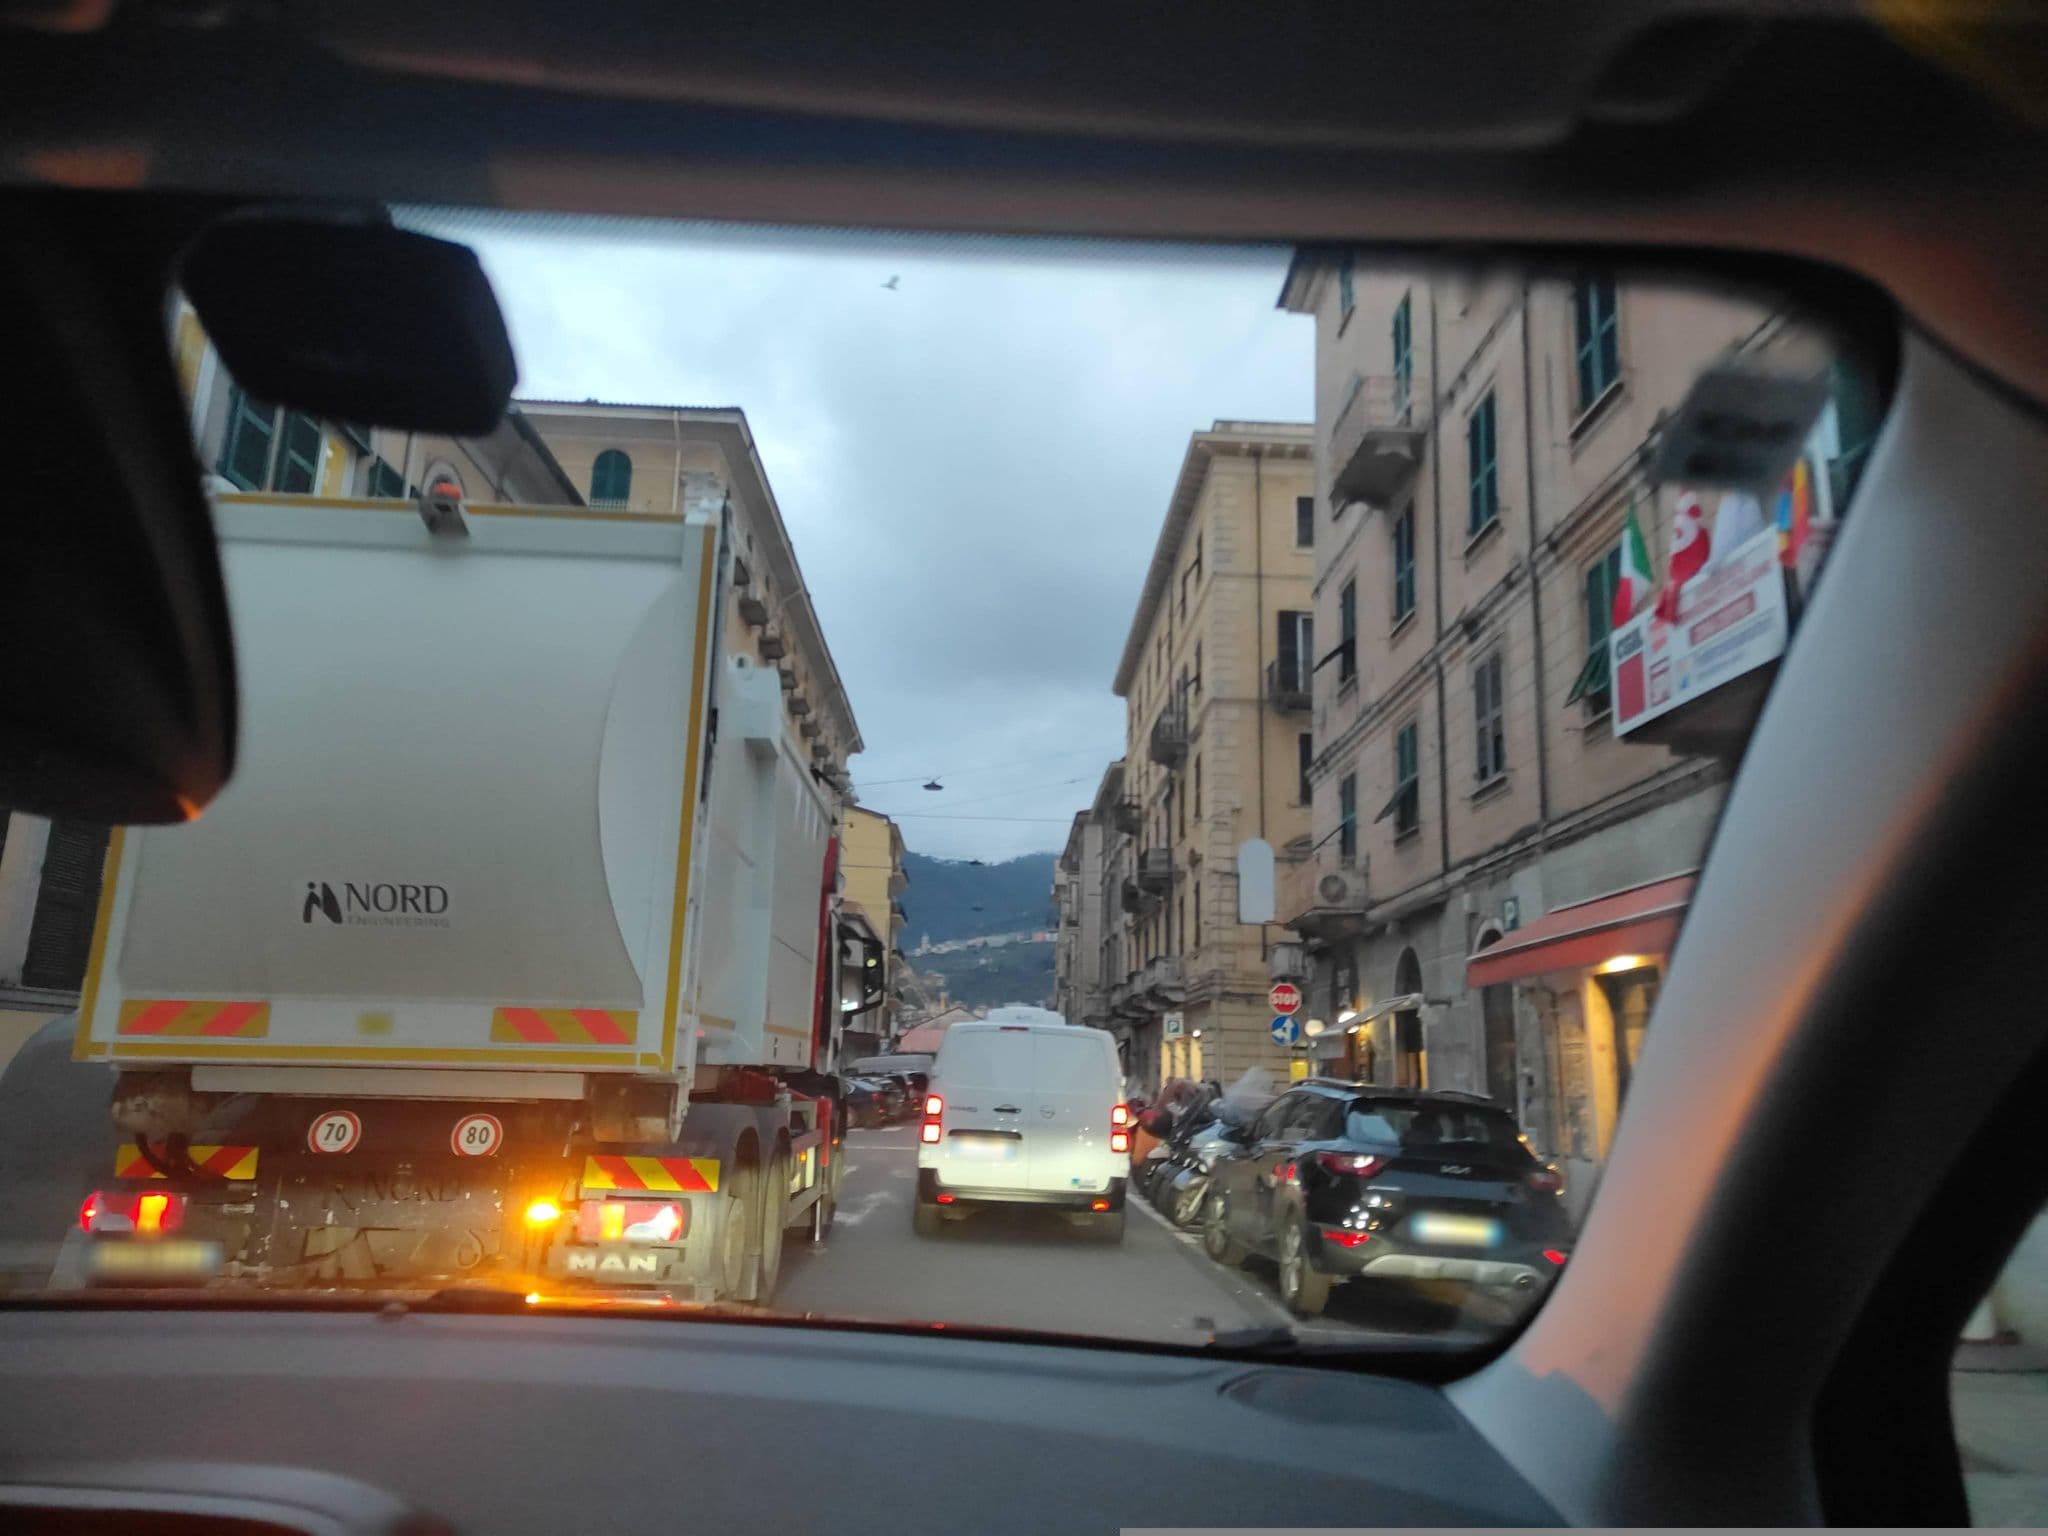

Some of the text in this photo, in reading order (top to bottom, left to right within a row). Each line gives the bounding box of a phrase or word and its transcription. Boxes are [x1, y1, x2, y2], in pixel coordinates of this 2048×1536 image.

[344, 882, 449, 914] NORD
[1271, 992, 1299, 1005] STOP
[324, 1122, 348, 1142] 70
[465, 1126, 491, 1145] 80
[567, 1253, 658, 1272] MAN
